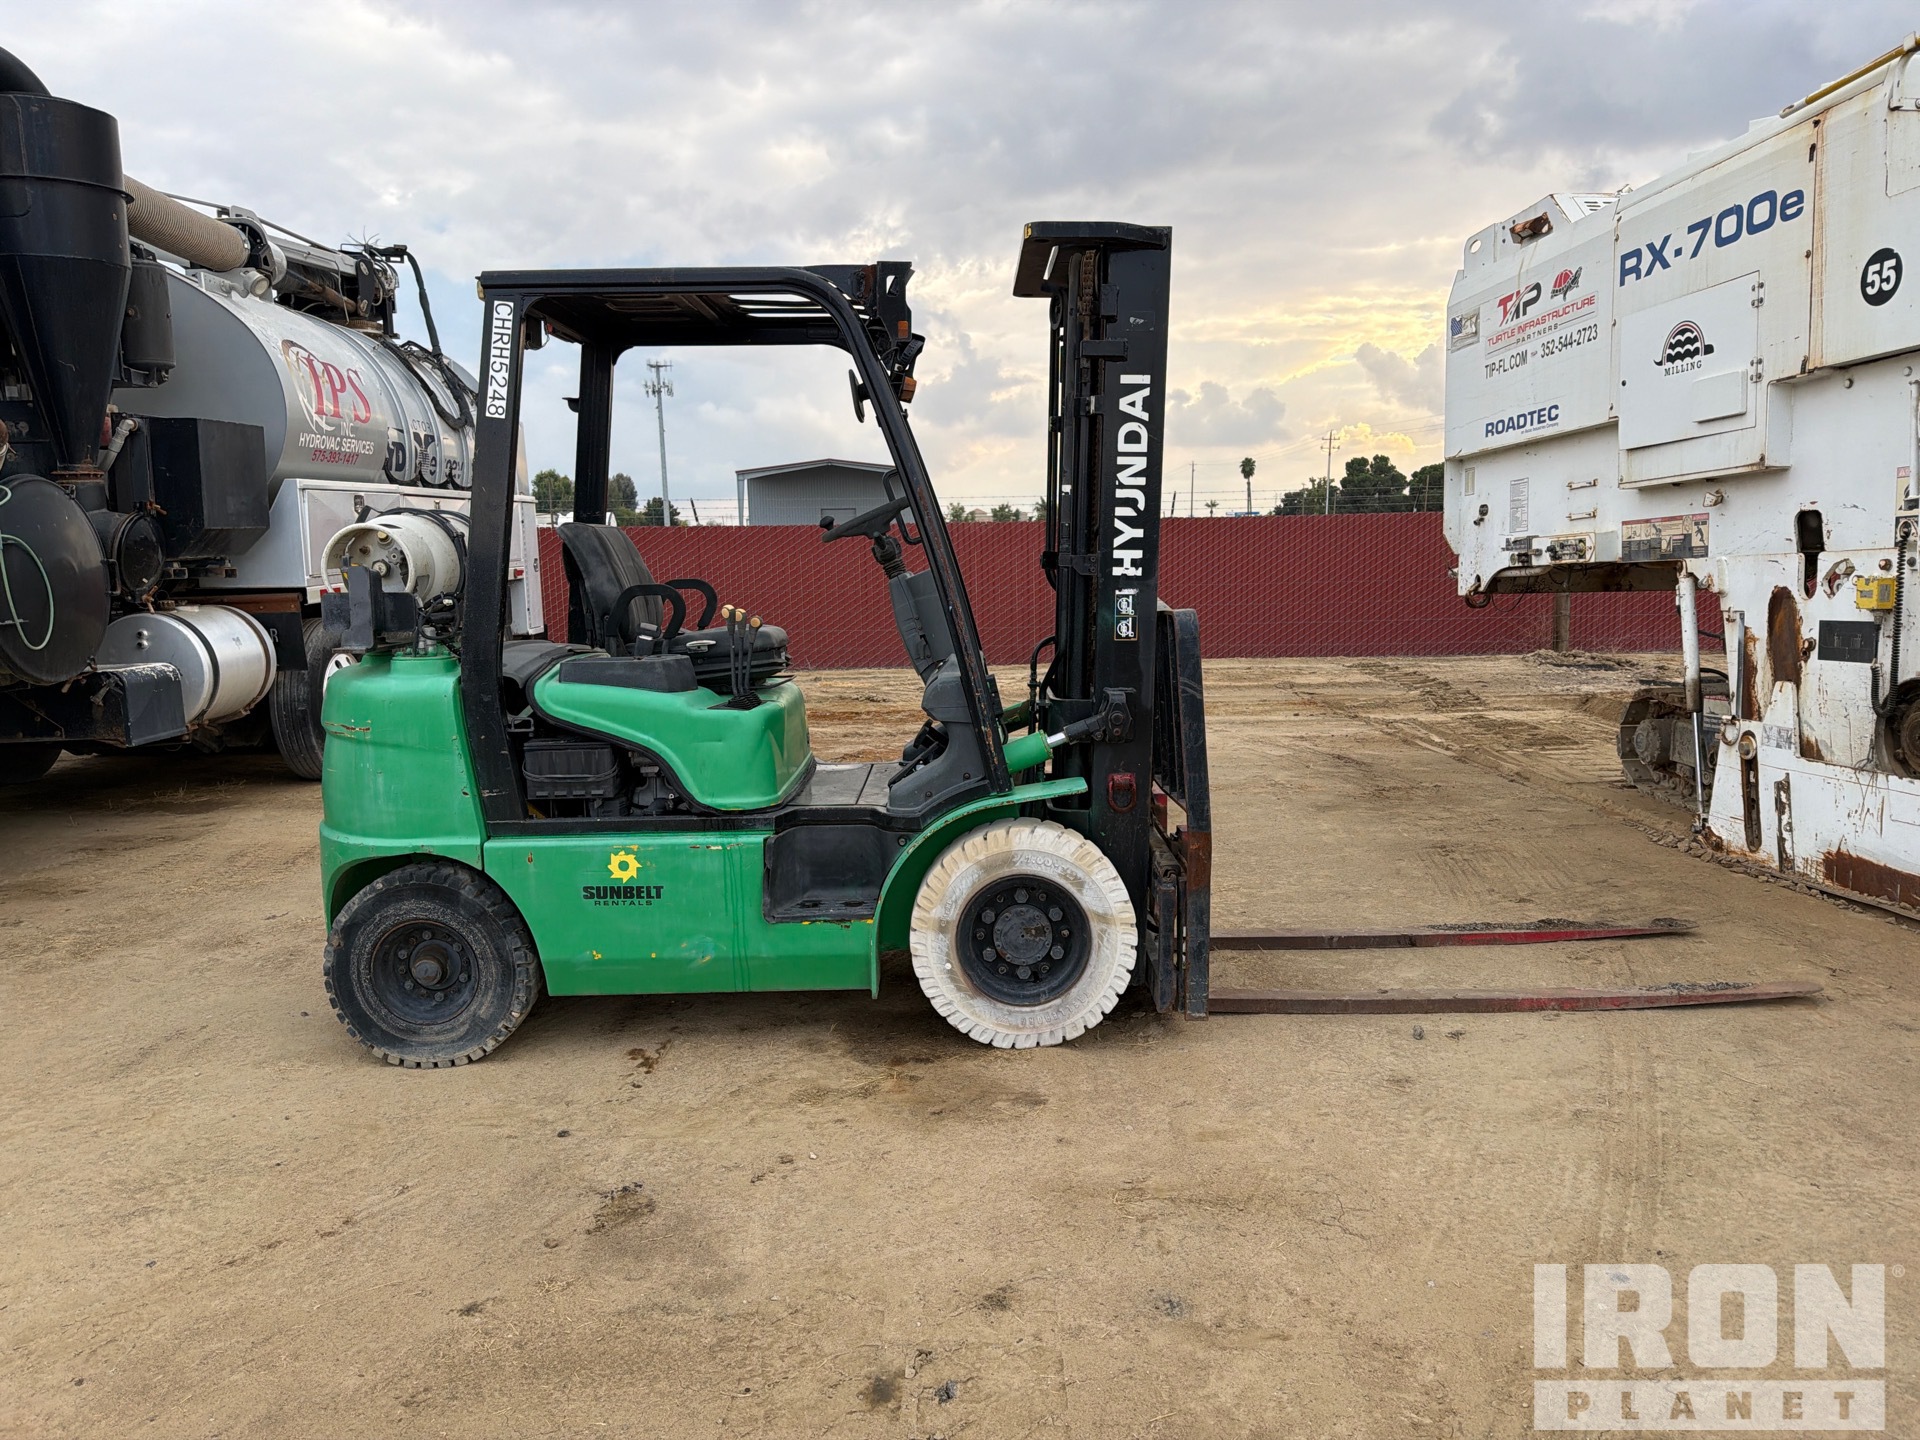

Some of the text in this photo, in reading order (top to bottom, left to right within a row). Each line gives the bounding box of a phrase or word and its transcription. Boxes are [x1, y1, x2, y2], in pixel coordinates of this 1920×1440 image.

[1619, 189, 1805, 287] RX-700e
[1866, 258, 1897, 296] 55
[1488, 295, 1595, 346] TURTLE INFRASTRUCTURE
[1497, 282, 1542, 327] TIP
[1485, 323, 1598, 379] TIP-FL.COM 352-544-2723
[1516, 323, 1559, 345] PARTNERS
[487, 303, 513, 416] CHRH5248
[1664, 360, 1702, 376] MILLING
[301, 356, 371, 424] IPS
[340, 421, 356, 438] INC.
[1485, 404, 1559, 438] ROADTEC
[298, 433, 374, 455] HYDROVAC SERVICES
[312, 450, 359, 465] 575-393-1417
[1112, 374, 1152, 577] HYUNDAI
[583, 885, 664, 900] SUNBELT
